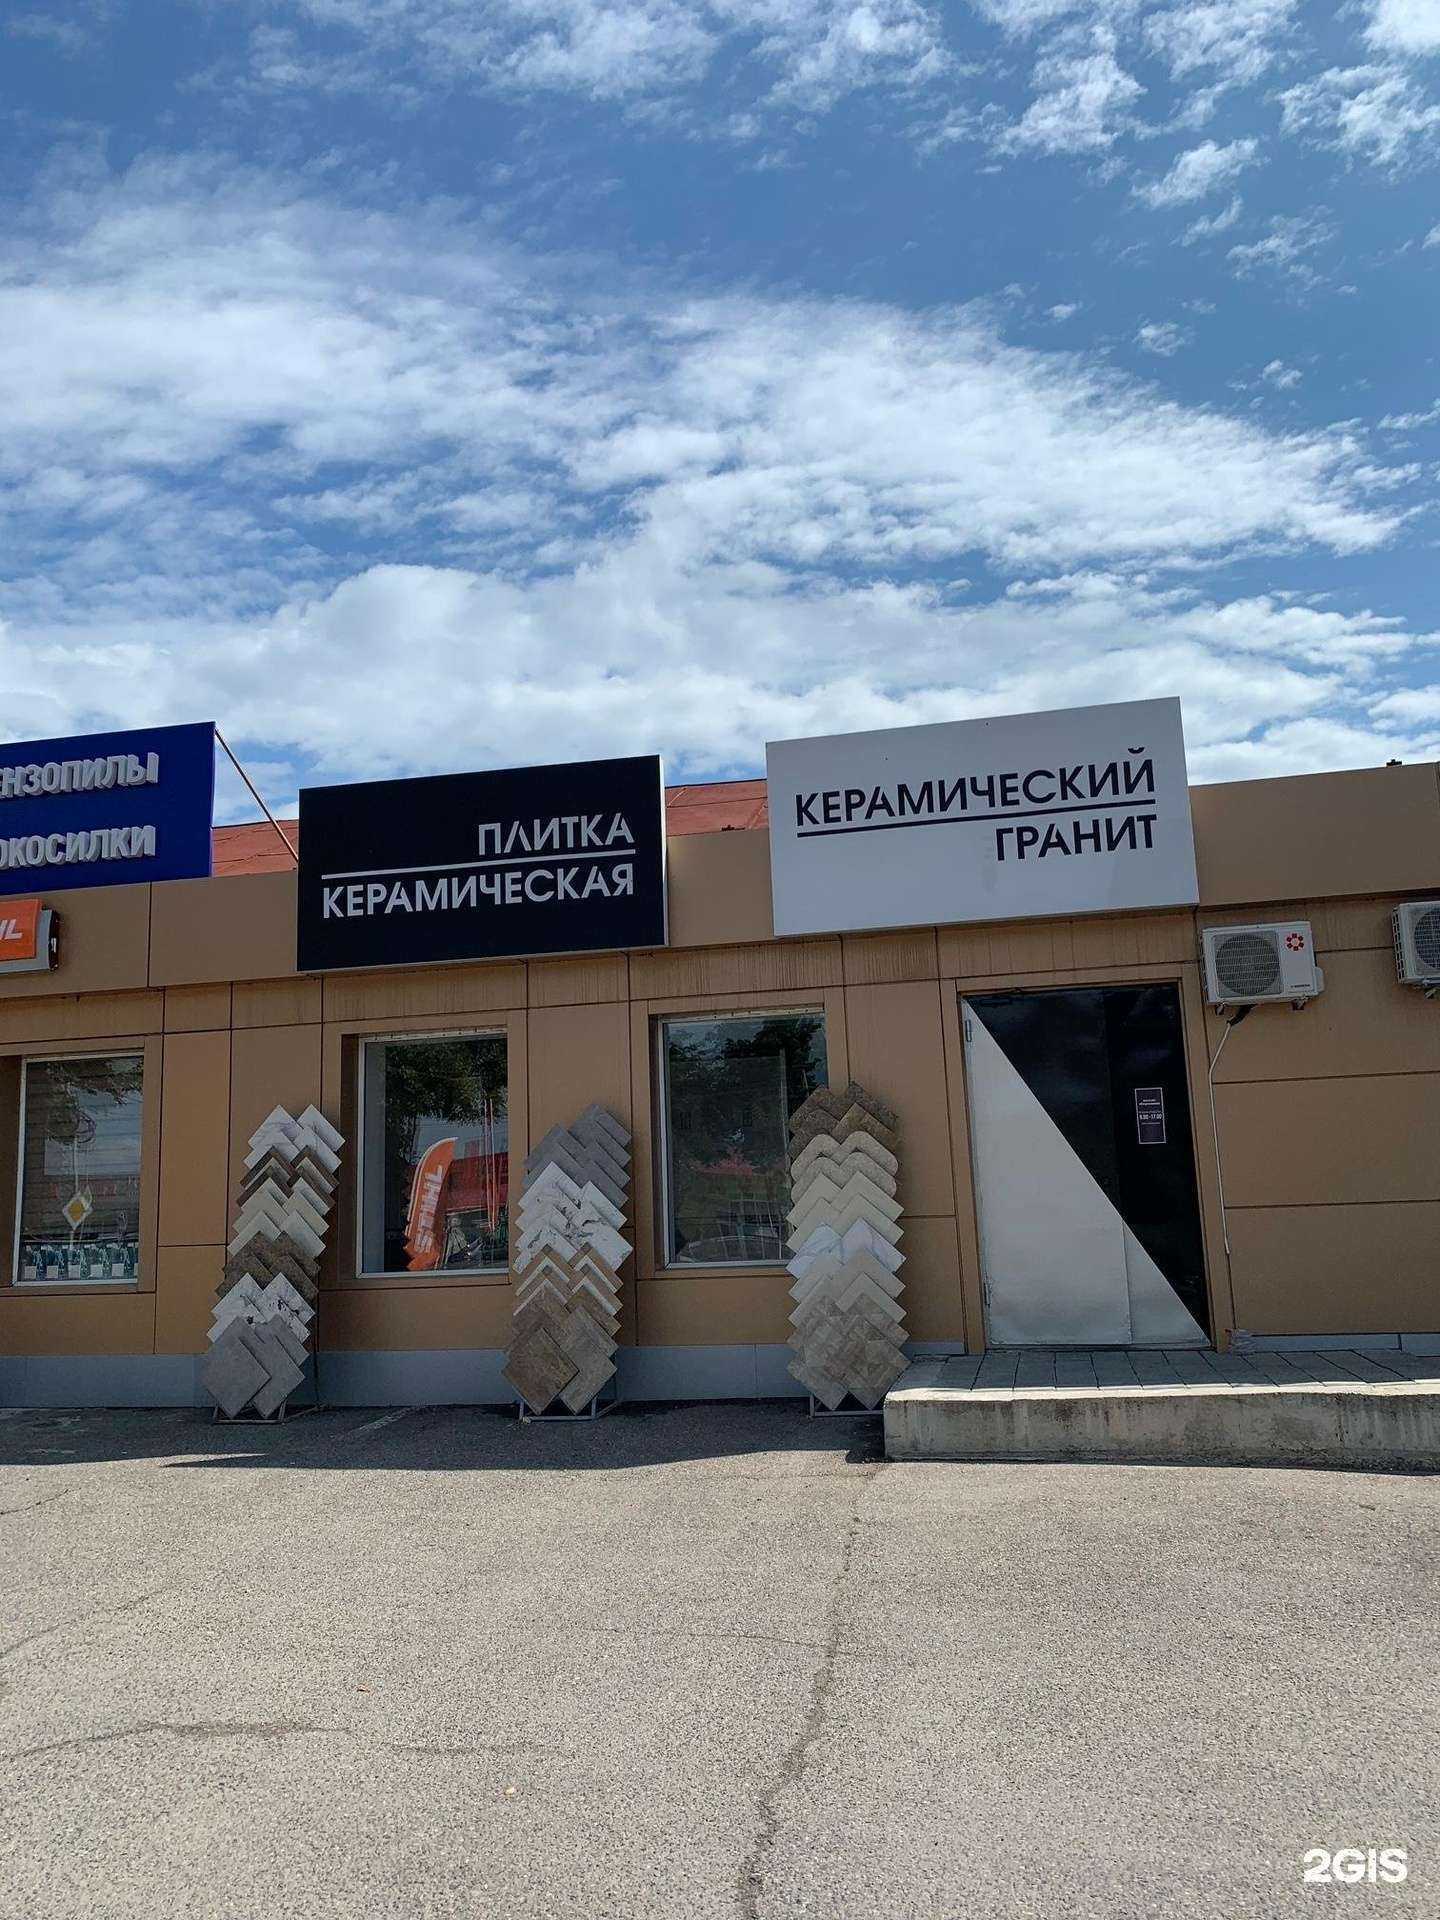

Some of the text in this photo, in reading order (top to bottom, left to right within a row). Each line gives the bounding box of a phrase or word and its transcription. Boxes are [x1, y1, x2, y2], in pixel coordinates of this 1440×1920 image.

[796, 746, 1155, 827] КЕРАМИЧЕСКИЙ
[478, 813, 635, 856] ПЛИТКА
[996, 814, 1157, 861] ГРАНИТ
[322, 863, 635, 919] КЕРАМИЧЕСКАЯ
